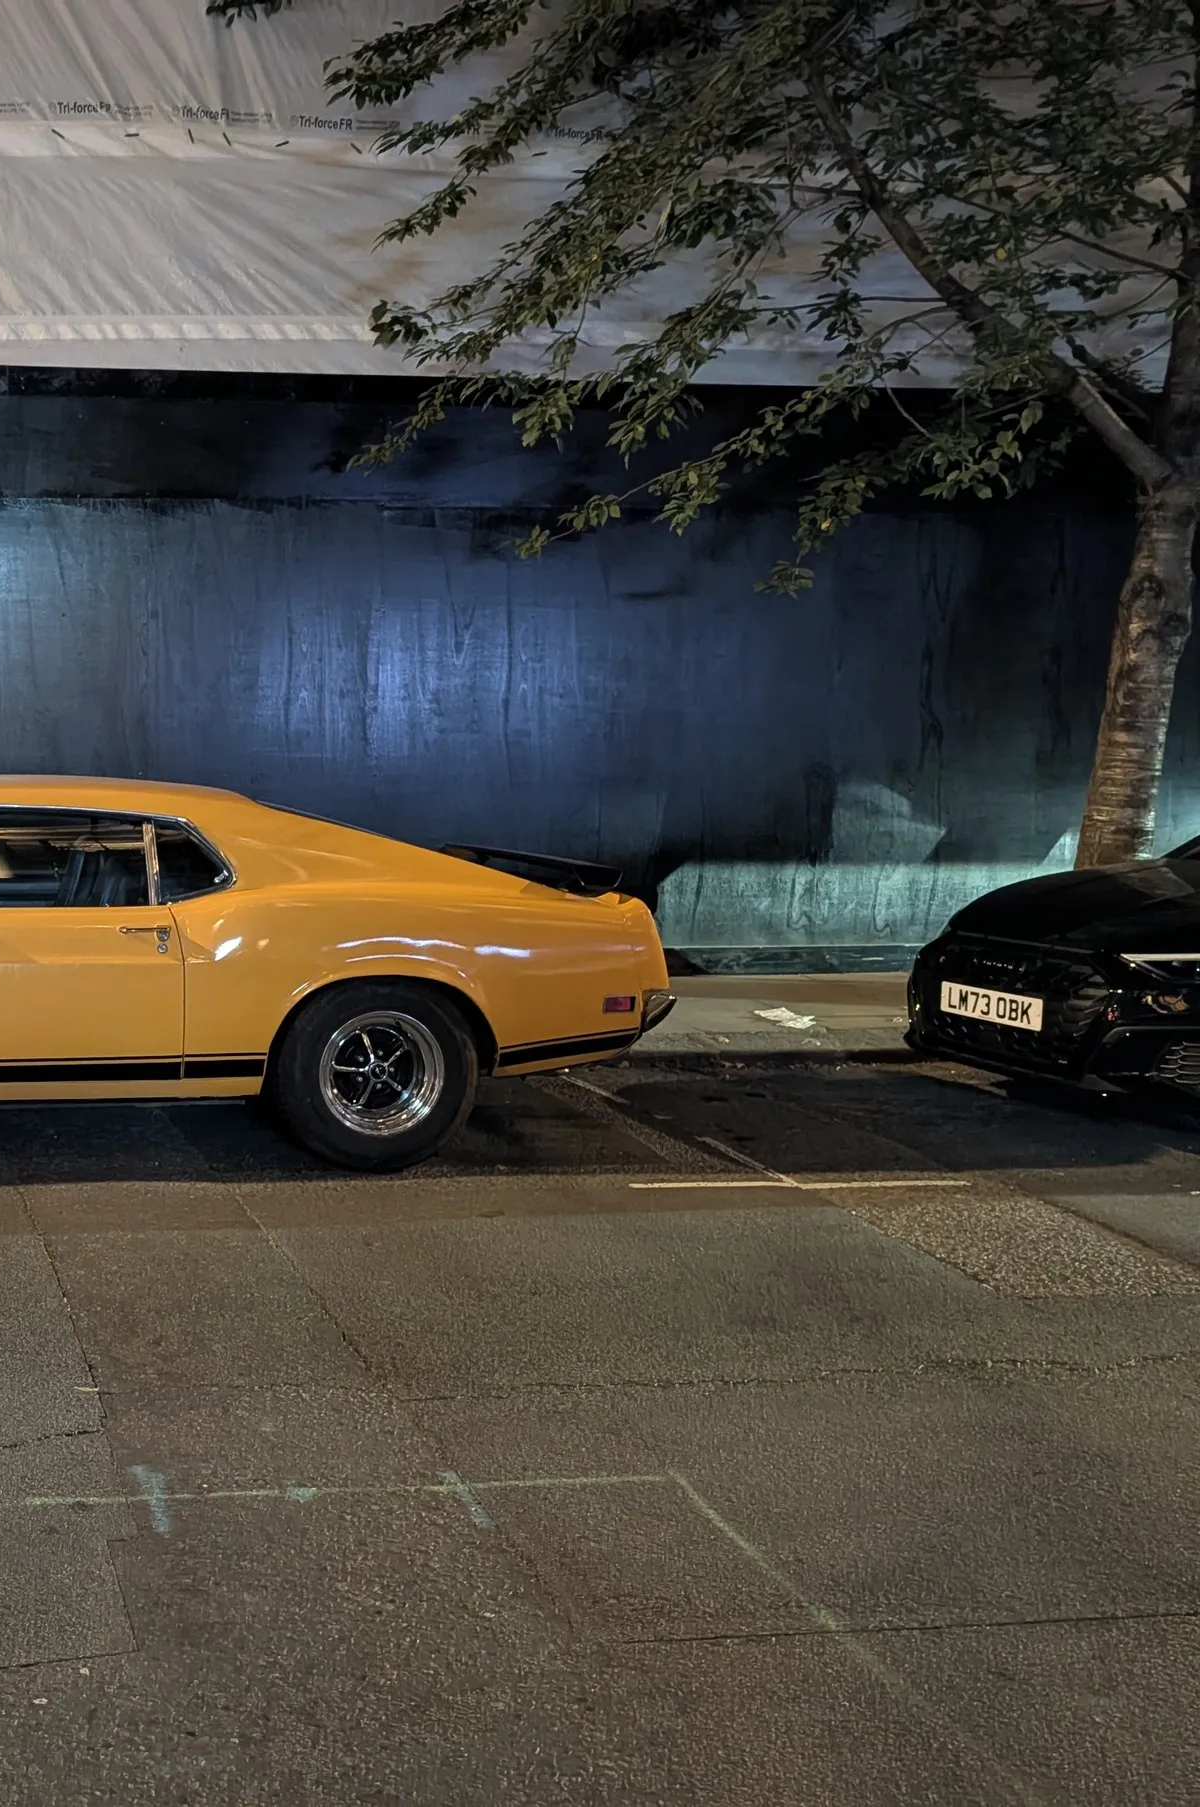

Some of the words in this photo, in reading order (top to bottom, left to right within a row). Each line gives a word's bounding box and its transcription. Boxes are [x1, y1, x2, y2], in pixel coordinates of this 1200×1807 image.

[299, 116, 338, 130] Tri-force
[339, 118, 353, 130] FR
[947, 986, 992, 1016] LM73
[996, 997, 1032, 1025] OBK
